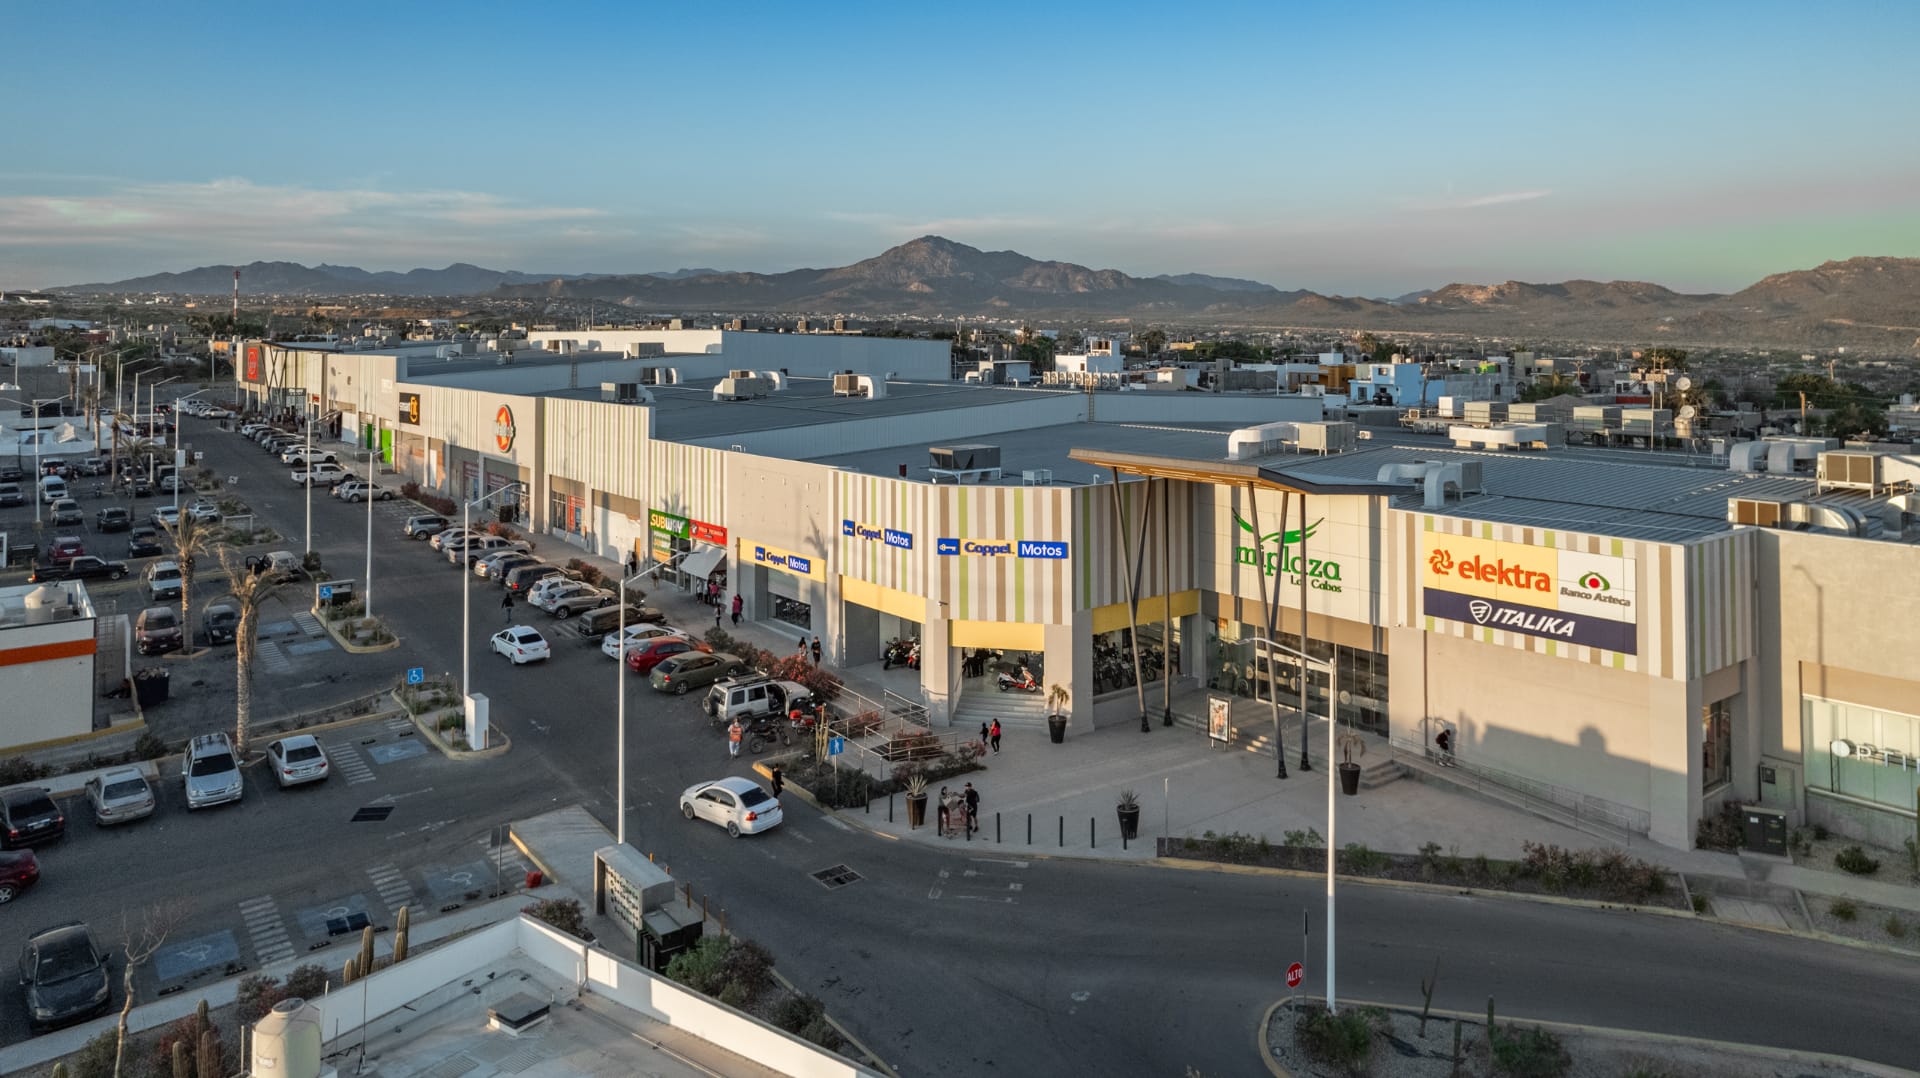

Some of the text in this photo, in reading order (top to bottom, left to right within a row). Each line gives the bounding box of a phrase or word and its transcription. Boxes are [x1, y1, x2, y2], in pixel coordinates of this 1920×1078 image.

[650, 514, 684, 534] SUBWAY
[886, 531, 909, 547] Motos
[1021, 543, 1062, 556] Motos
[789, 557, 808, 571] Motos
[1458, 555, 1551, 592] elektra
[1311, 579, 1342, 593] Cabos
[1560, 587, 1631, 607] Banco Azteca
[1492, 607, 1576, 637] ITALIKA
[1287, 968, 1303, 982] ALTO
